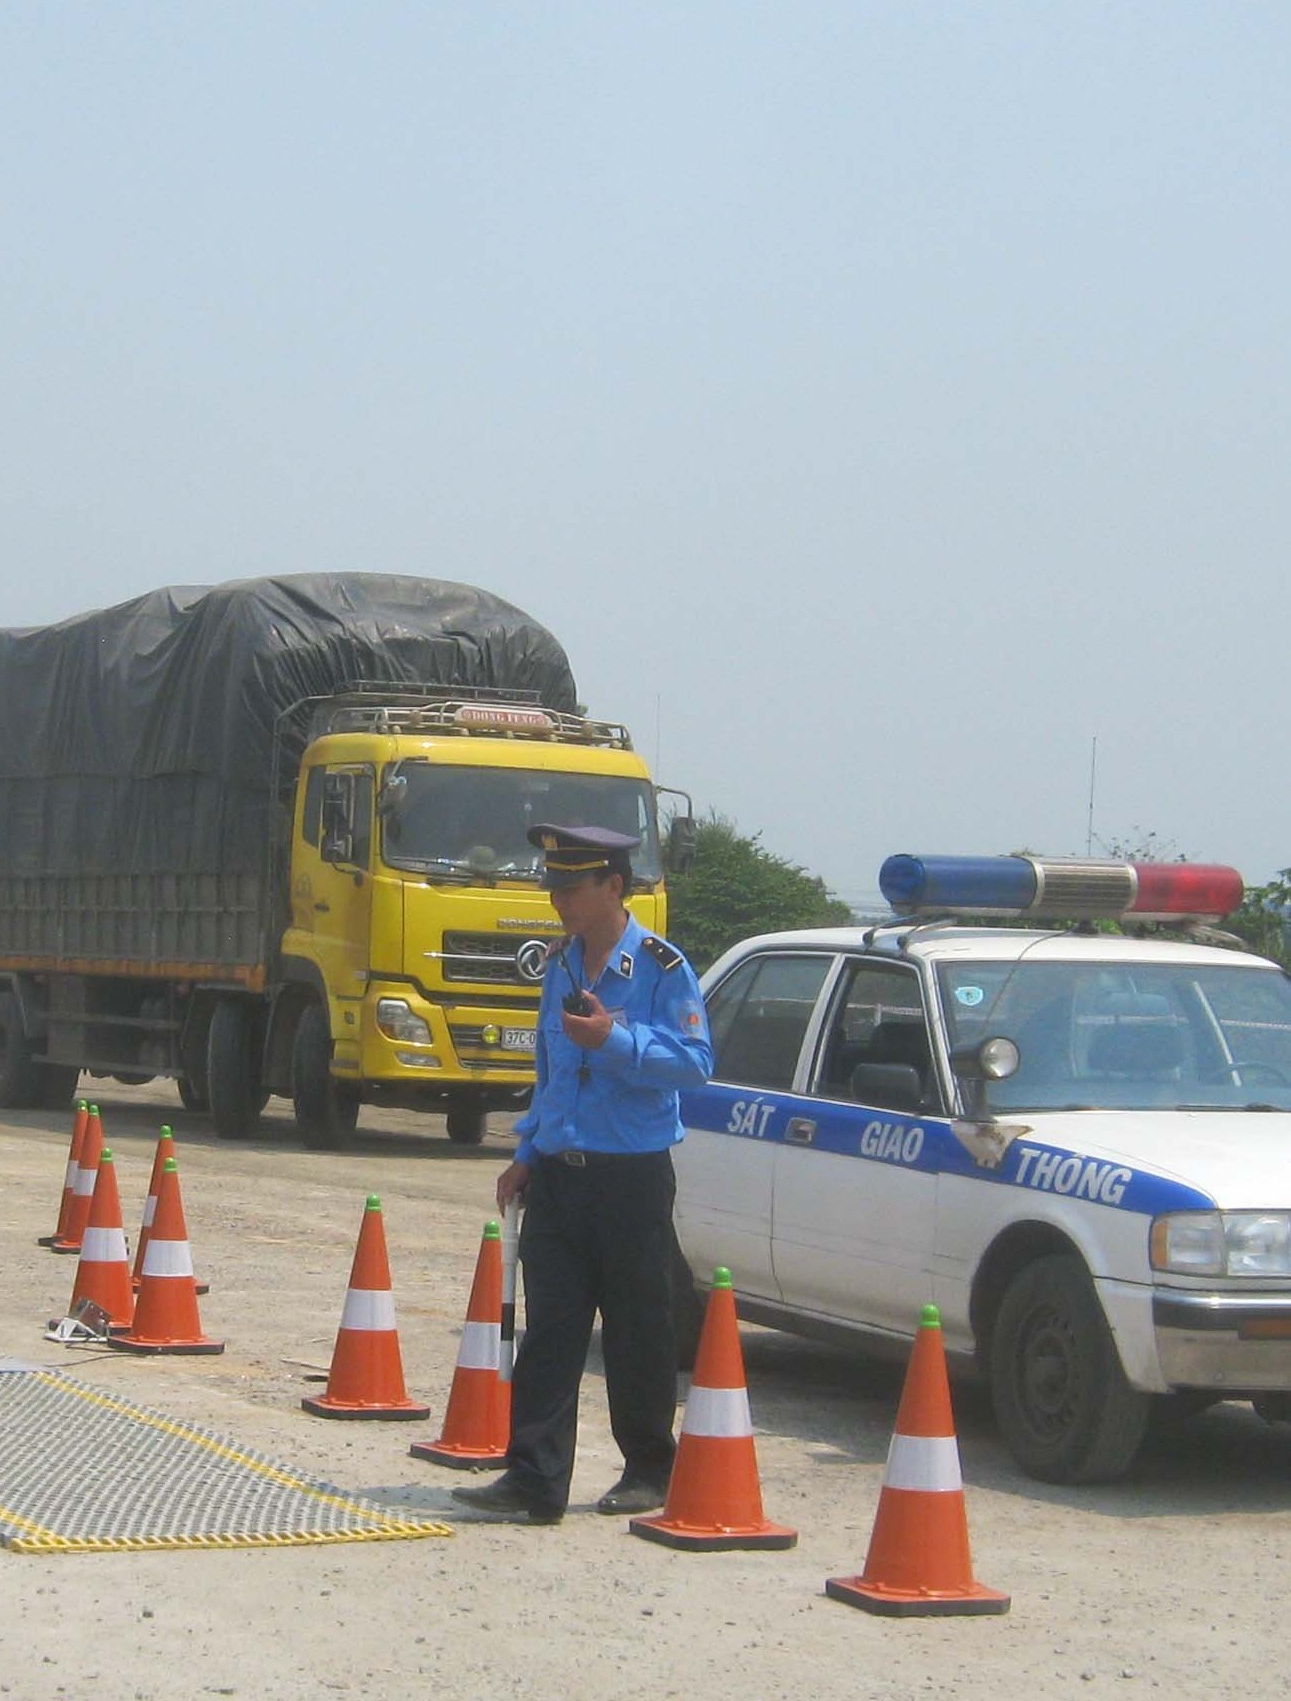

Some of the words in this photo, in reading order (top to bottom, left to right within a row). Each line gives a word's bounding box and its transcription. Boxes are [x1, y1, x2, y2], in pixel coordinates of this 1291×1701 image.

[507, 1031, 536, 1044] 37C-0
[727, 1097, 776, 1138] SÁT
[861, 1120, 925, 1163] GIAO
[1015, 1147, 1133, 1205] THÔNG
